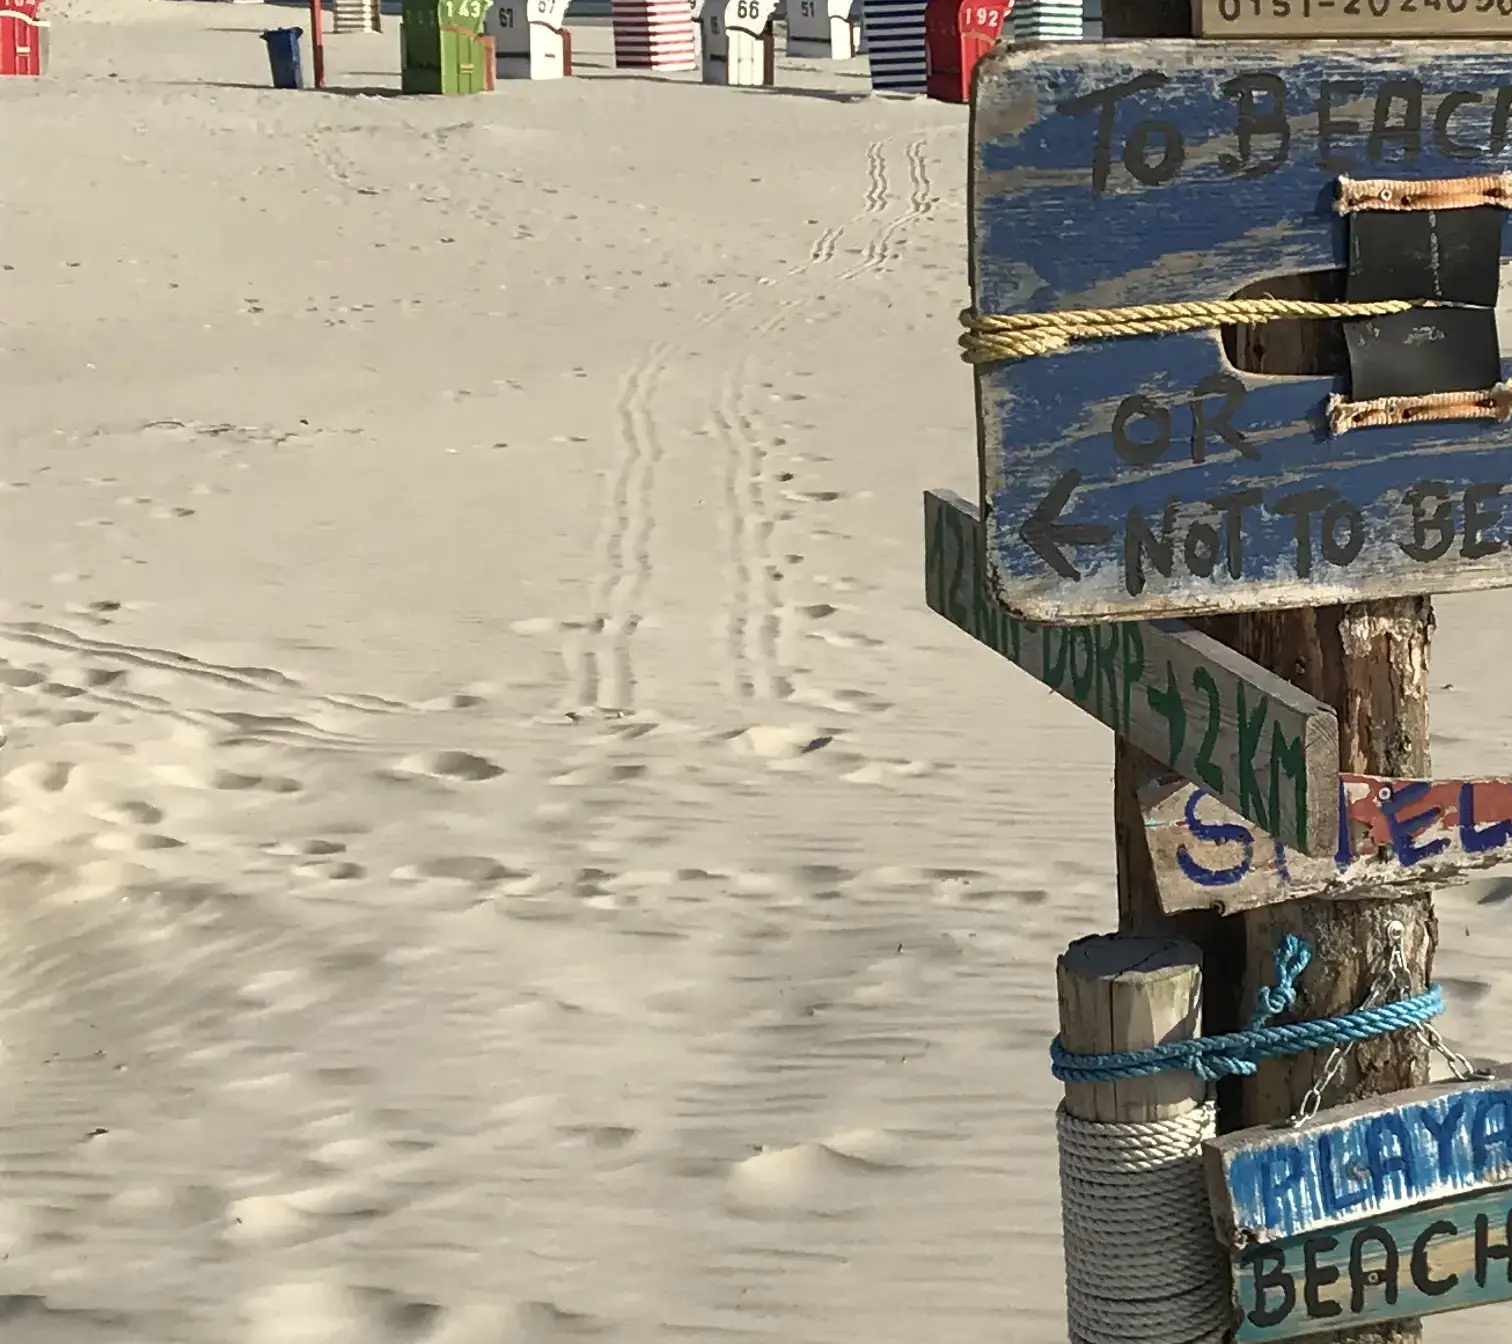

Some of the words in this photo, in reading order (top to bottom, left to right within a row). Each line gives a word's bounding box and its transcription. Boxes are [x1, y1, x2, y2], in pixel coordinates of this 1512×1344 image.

[446, 0, 481, 19] 143
[737, 0, 759, 19] 66
[801, 1, 815, 17] 51
[965, 7, 999, 27] 192
[1112, 372, 1262, 464] OR
[1275, 488, 1366, 579] TO
